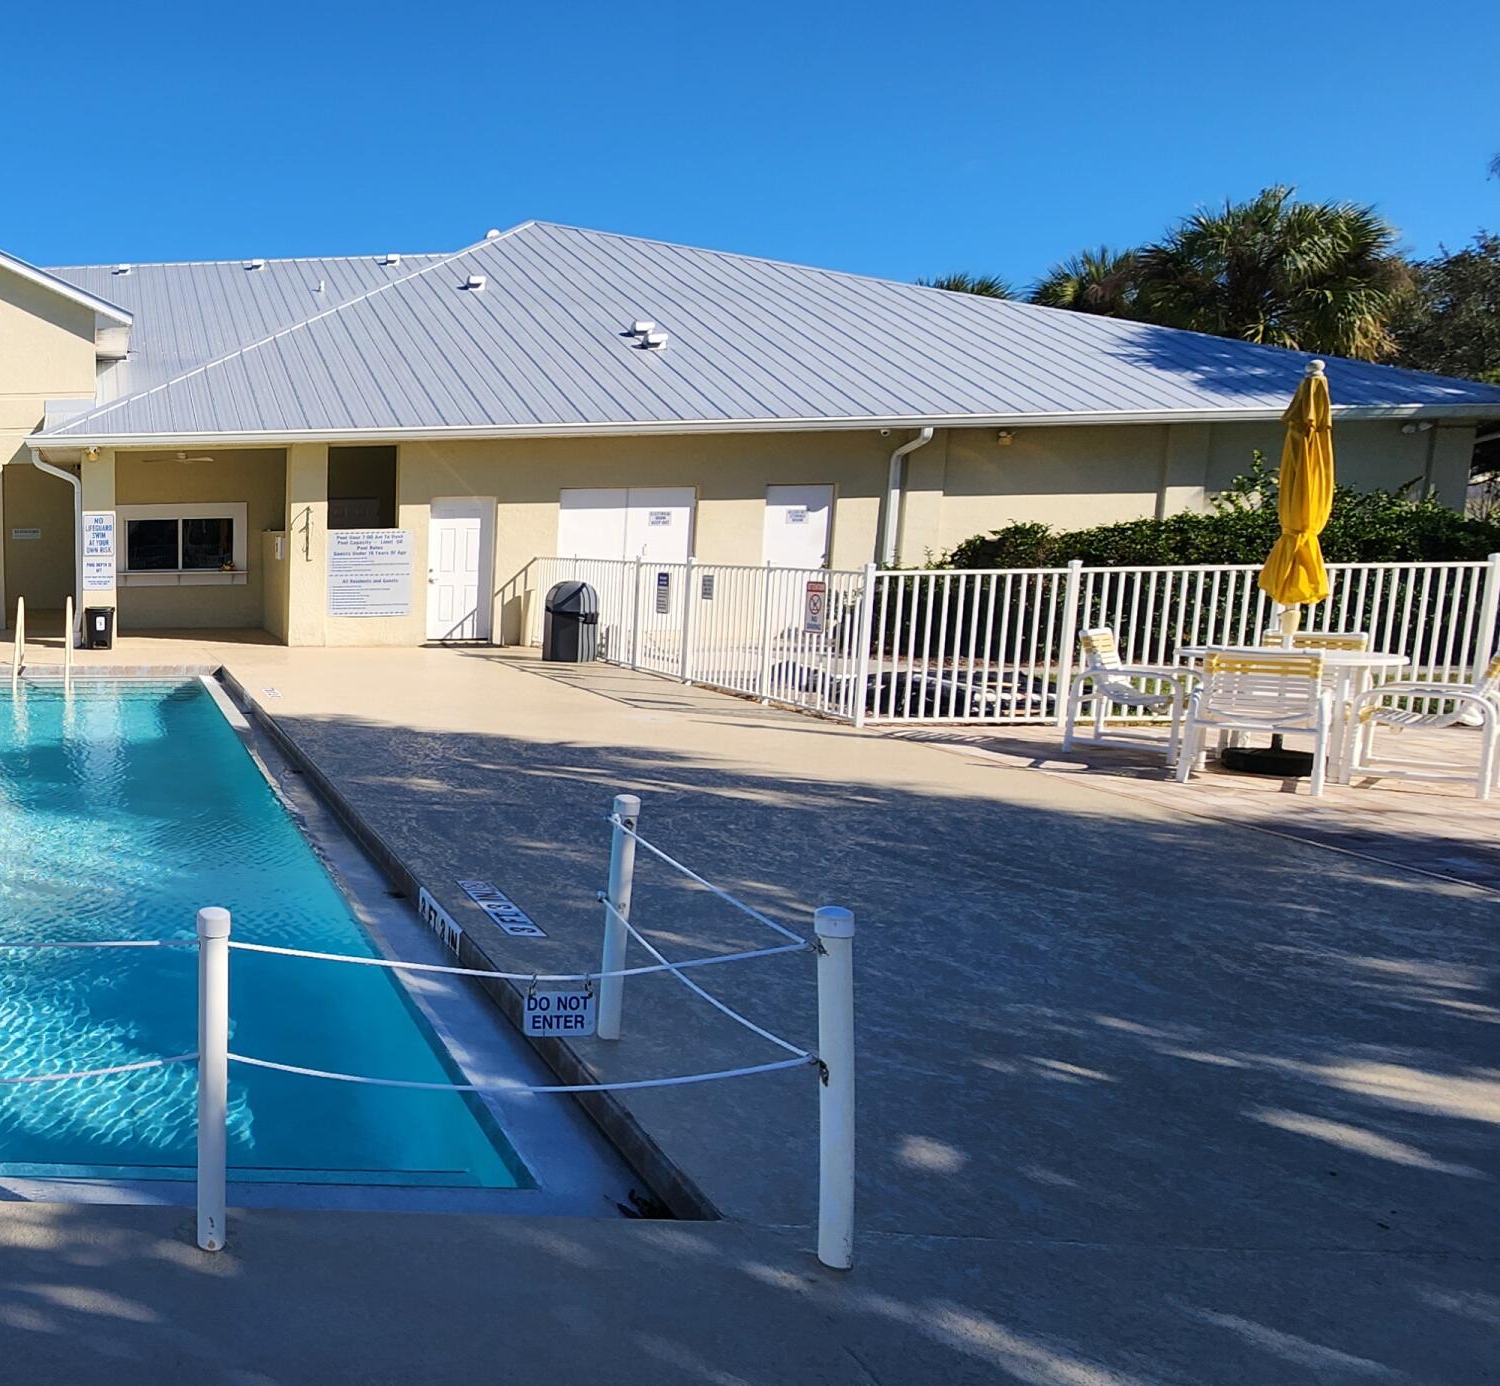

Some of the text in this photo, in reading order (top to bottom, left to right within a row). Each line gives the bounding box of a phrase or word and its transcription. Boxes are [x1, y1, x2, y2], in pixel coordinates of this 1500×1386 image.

[527, 996, 590, 1011] DO NOT
[531, 1014, 585, 1030] ENTER
